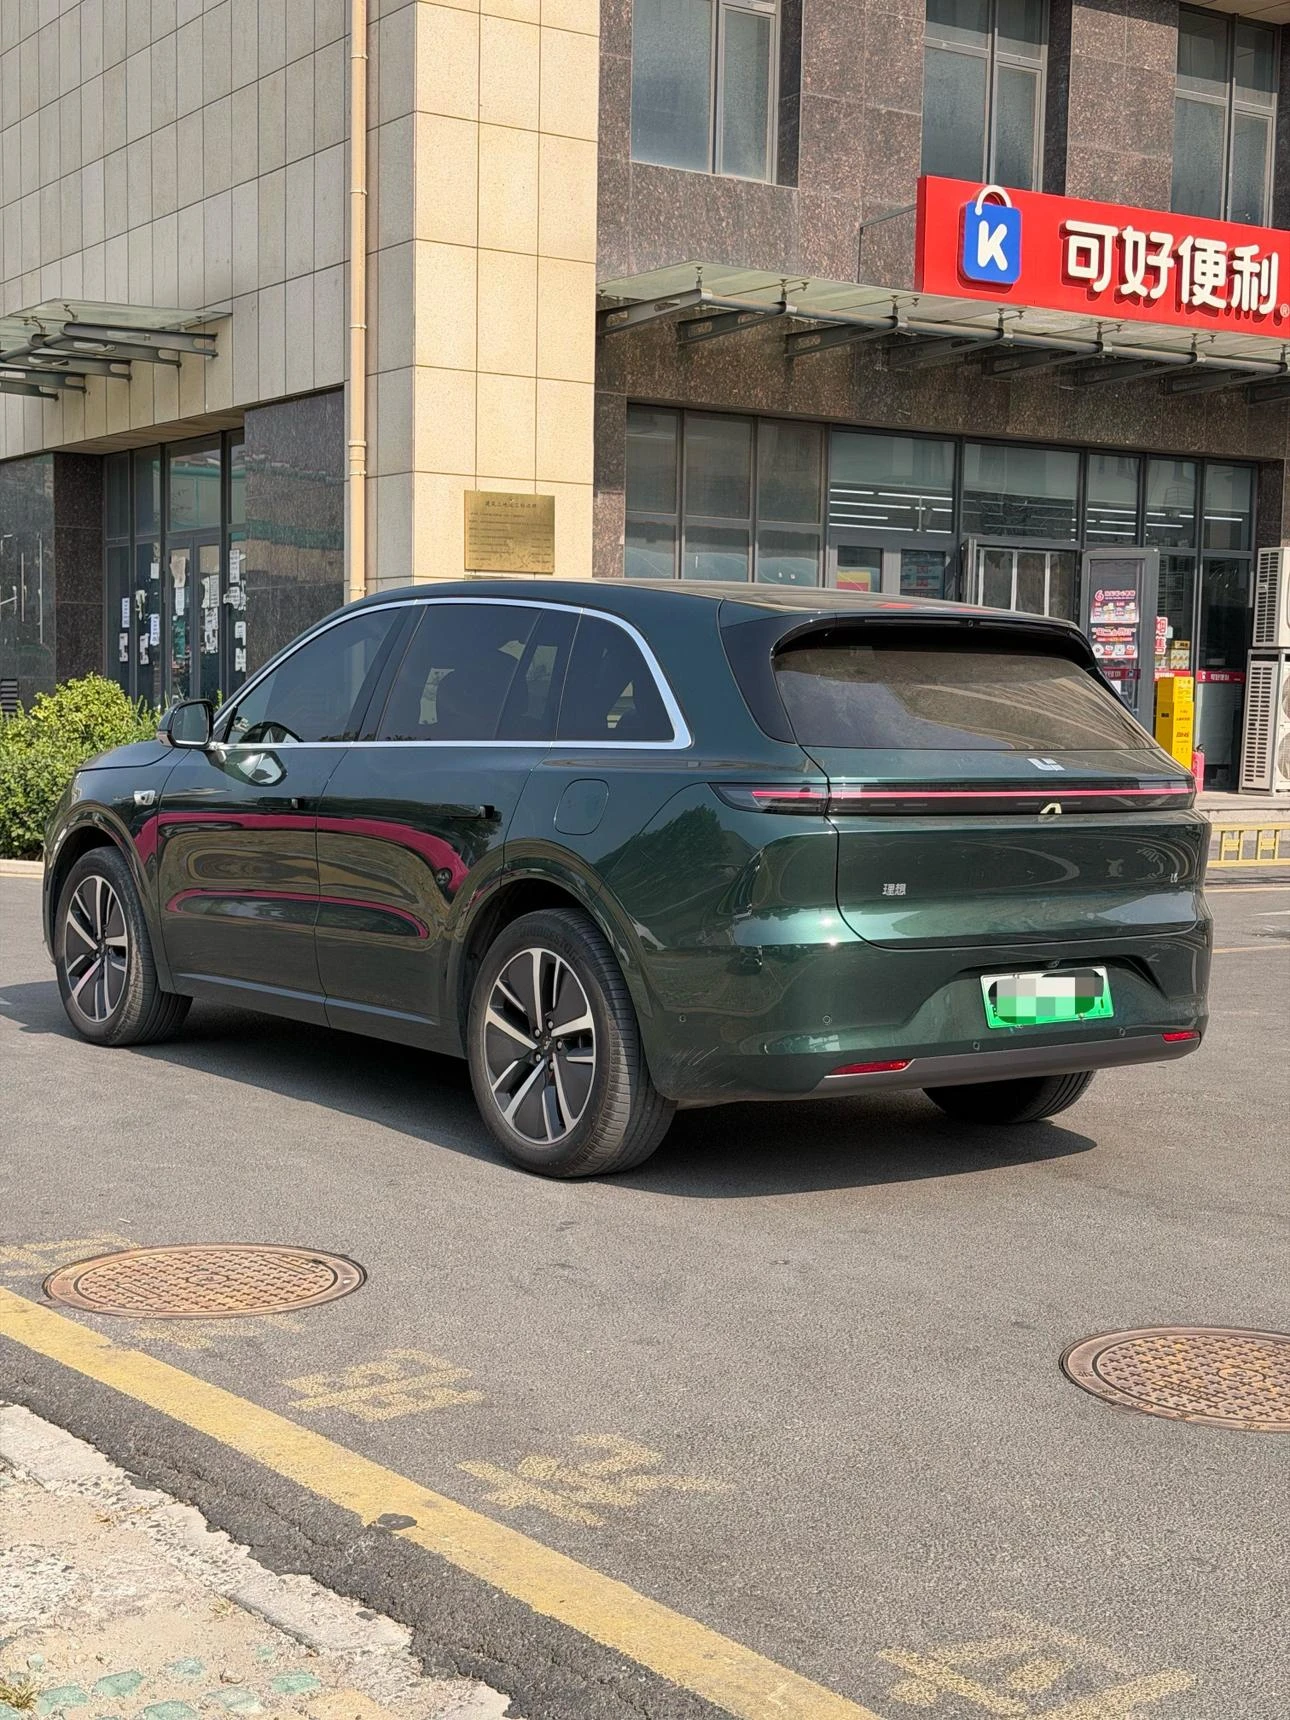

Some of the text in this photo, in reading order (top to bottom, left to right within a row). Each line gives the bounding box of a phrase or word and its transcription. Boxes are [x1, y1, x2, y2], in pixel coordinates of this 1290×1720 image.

[977, 220, 1008, 271] K
[1064, 219, 1279, 315] 可好便利
[882, 883, 907, 896] 理想
